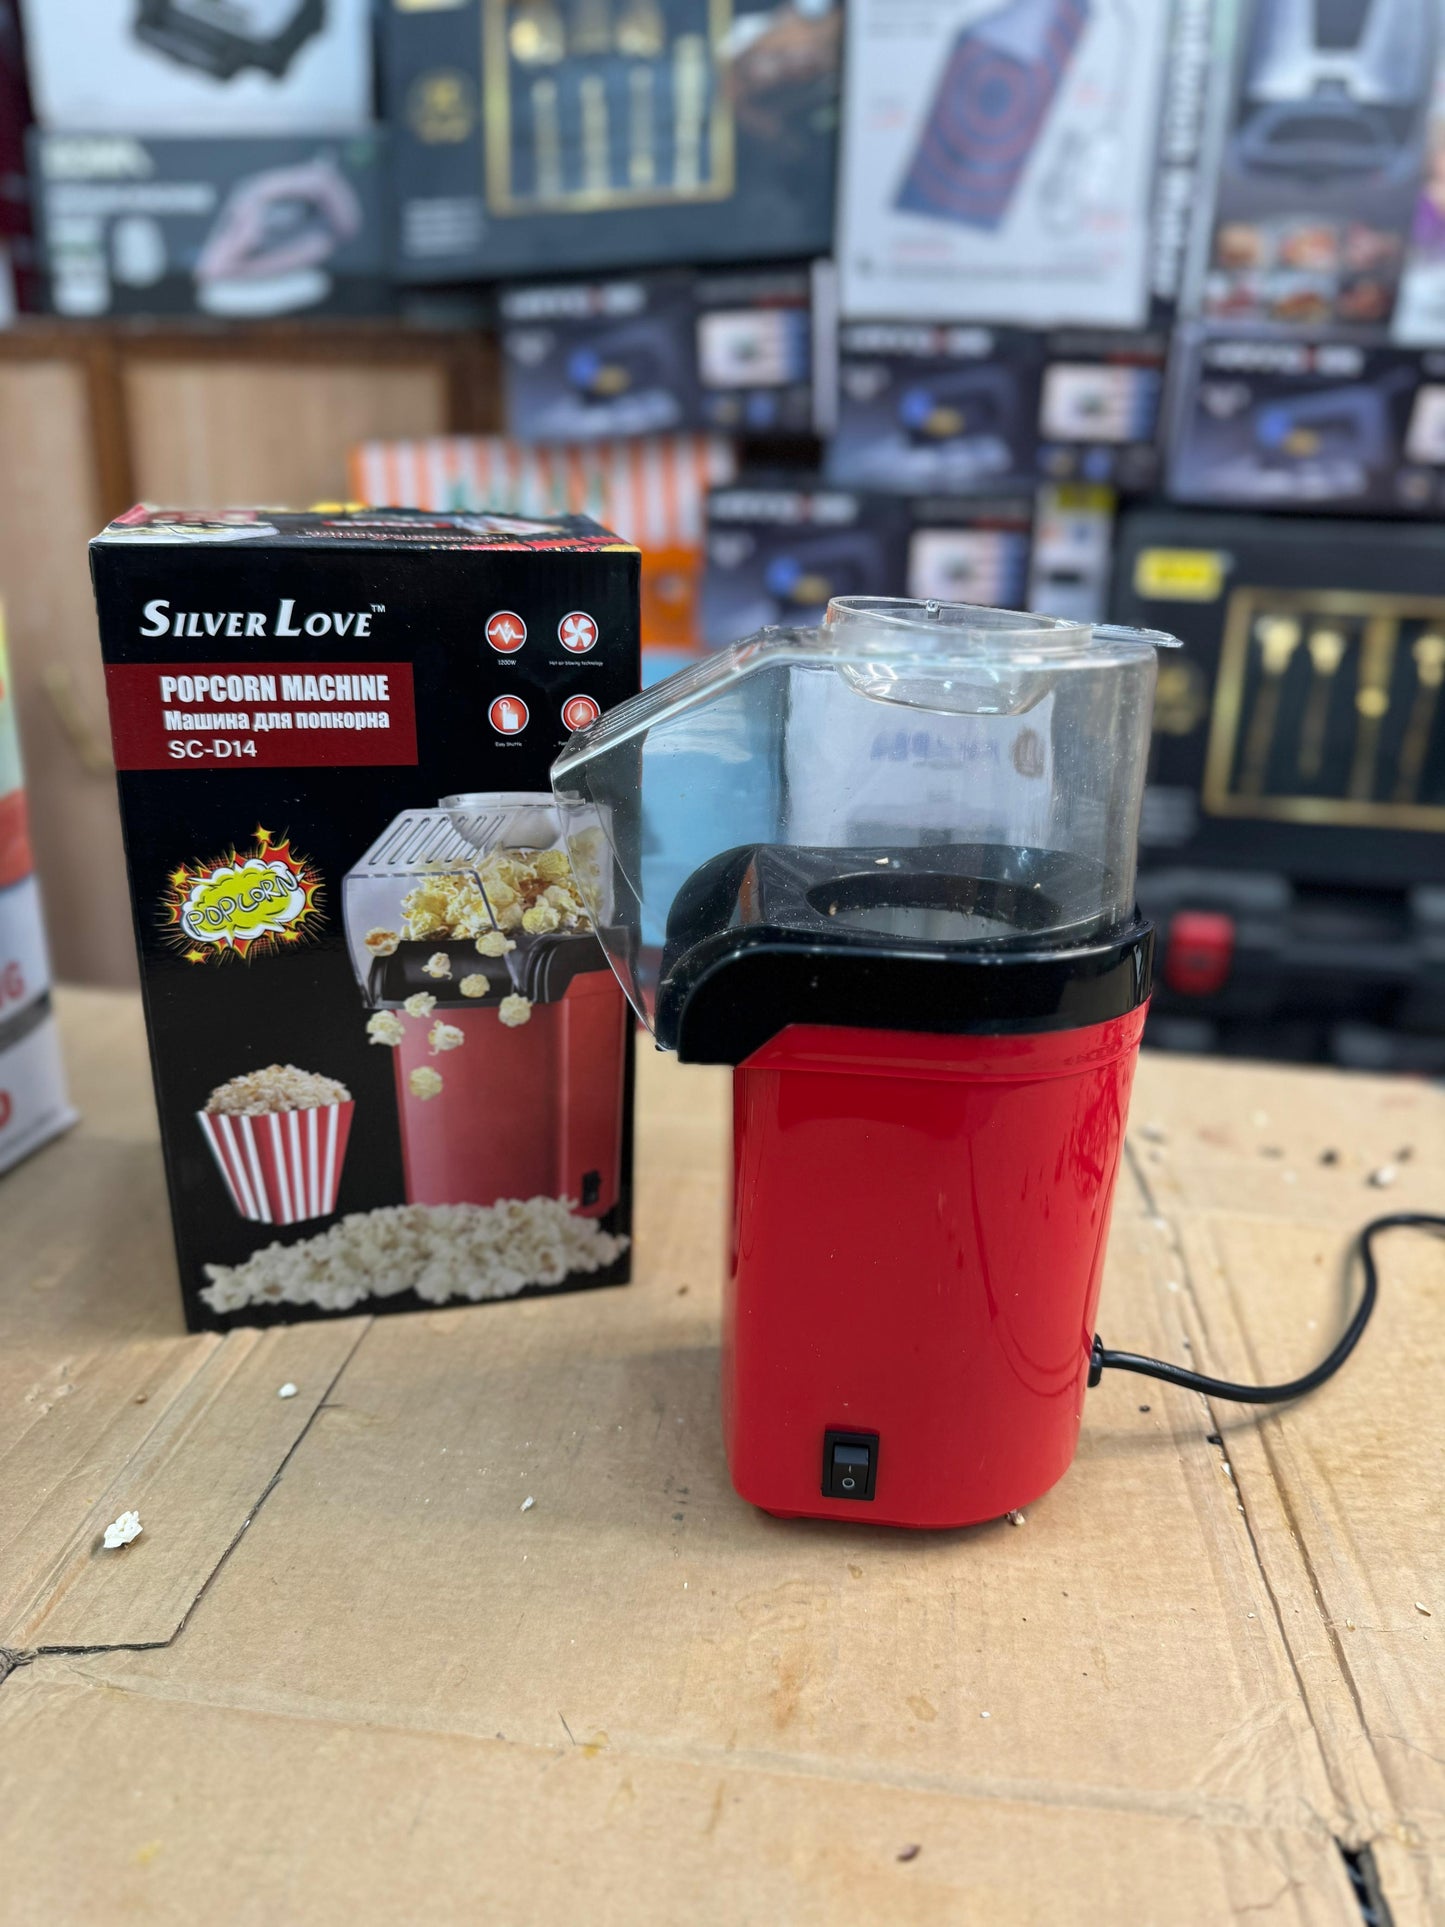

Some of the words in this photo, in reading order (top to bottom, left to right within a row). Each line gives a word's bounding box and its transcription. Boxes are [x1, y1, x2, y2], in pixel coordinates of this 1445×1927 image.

[159, 674, 277, 703] POPCORN
[280, 674, 390, 702] MACHINE
[163, 710, 250, 731] Машина
[253, 712, 294, 732] для
[295, 711, 390, 731] попкорна
[168, 740, 257, 760] SC-D14
[185, 868, 300, 937] POPCORN
